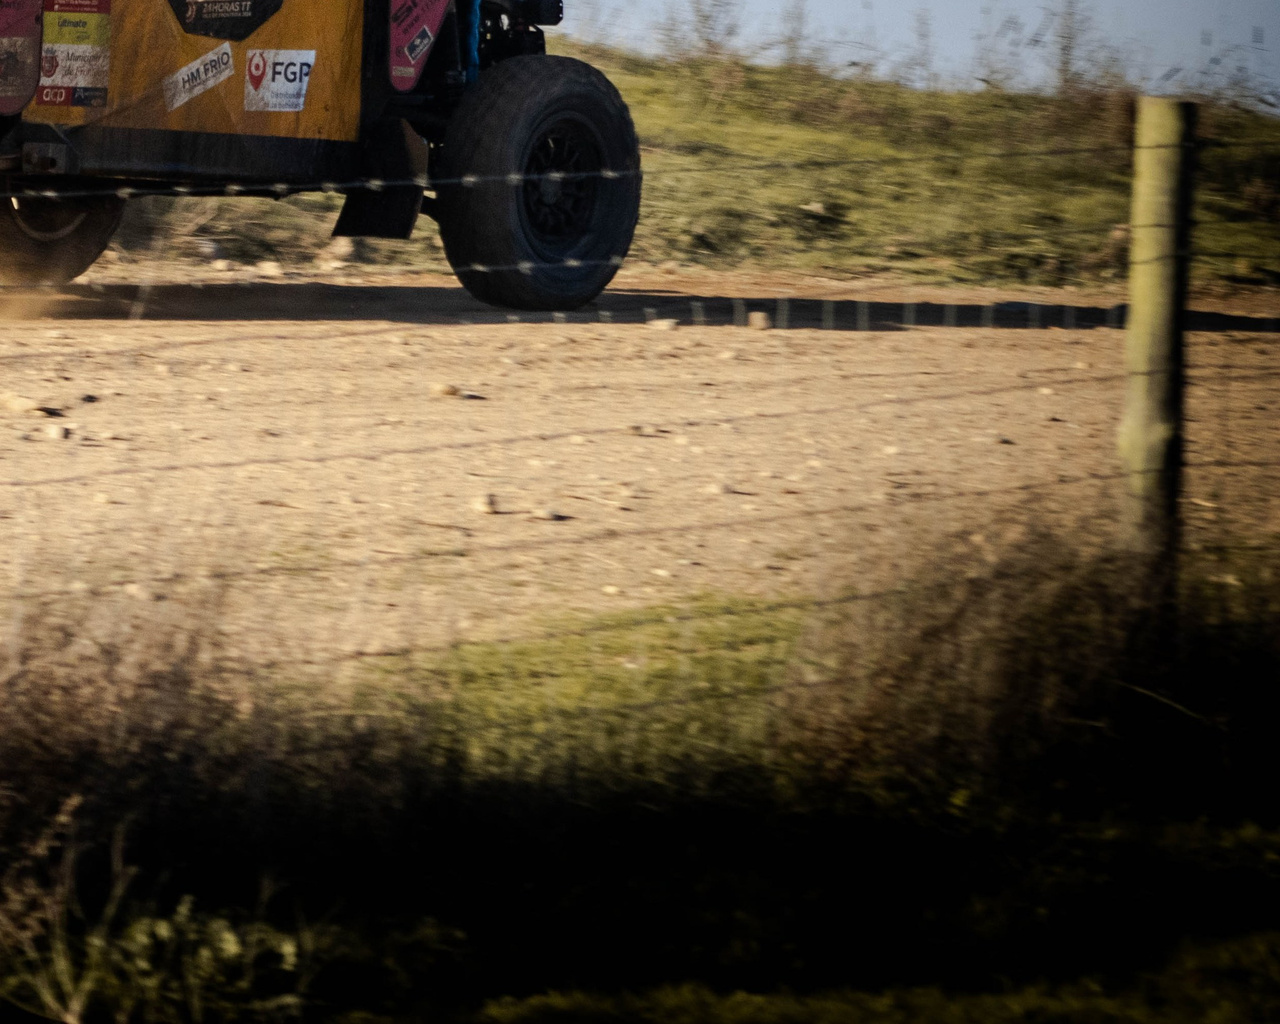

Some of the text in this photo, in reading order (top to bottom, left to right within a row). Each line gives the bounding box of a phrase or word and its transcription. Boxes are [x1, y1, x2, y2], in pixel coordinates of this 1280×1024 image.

[182, 67, 202, 90] HM
[203, 51, 231, 78] FRIO
[271, 61, 312, 83] FGP
[42, 88, 66, 104] acp
